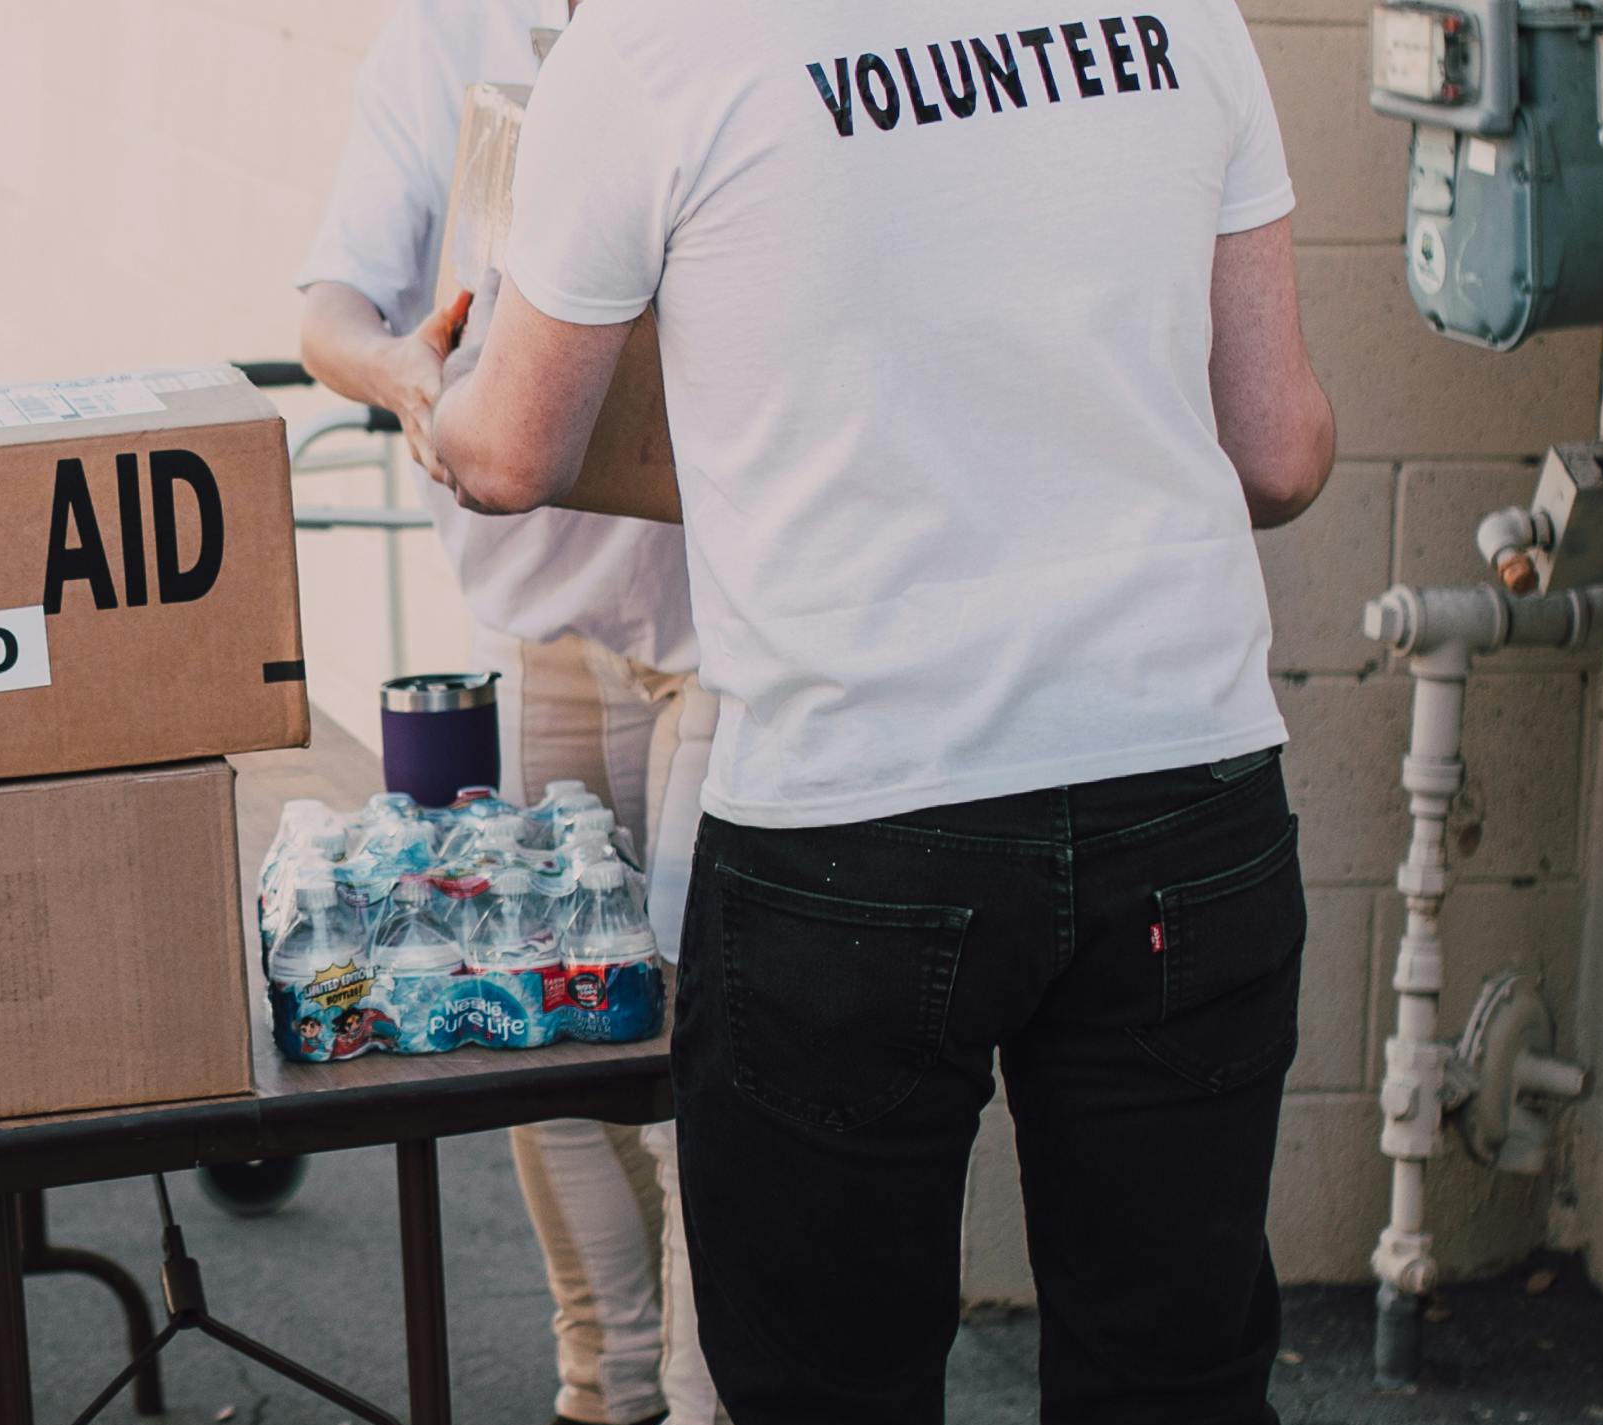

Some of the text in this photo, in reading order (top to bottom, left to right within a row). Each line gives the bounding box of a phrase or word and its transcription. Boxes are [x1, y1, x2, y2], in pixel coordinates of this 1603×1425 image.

[805, 14, 1179, 138] VOLUNTEER
[43, 449, 224, 616] AID
[429, 1012, 525, 1042] Pure Life
